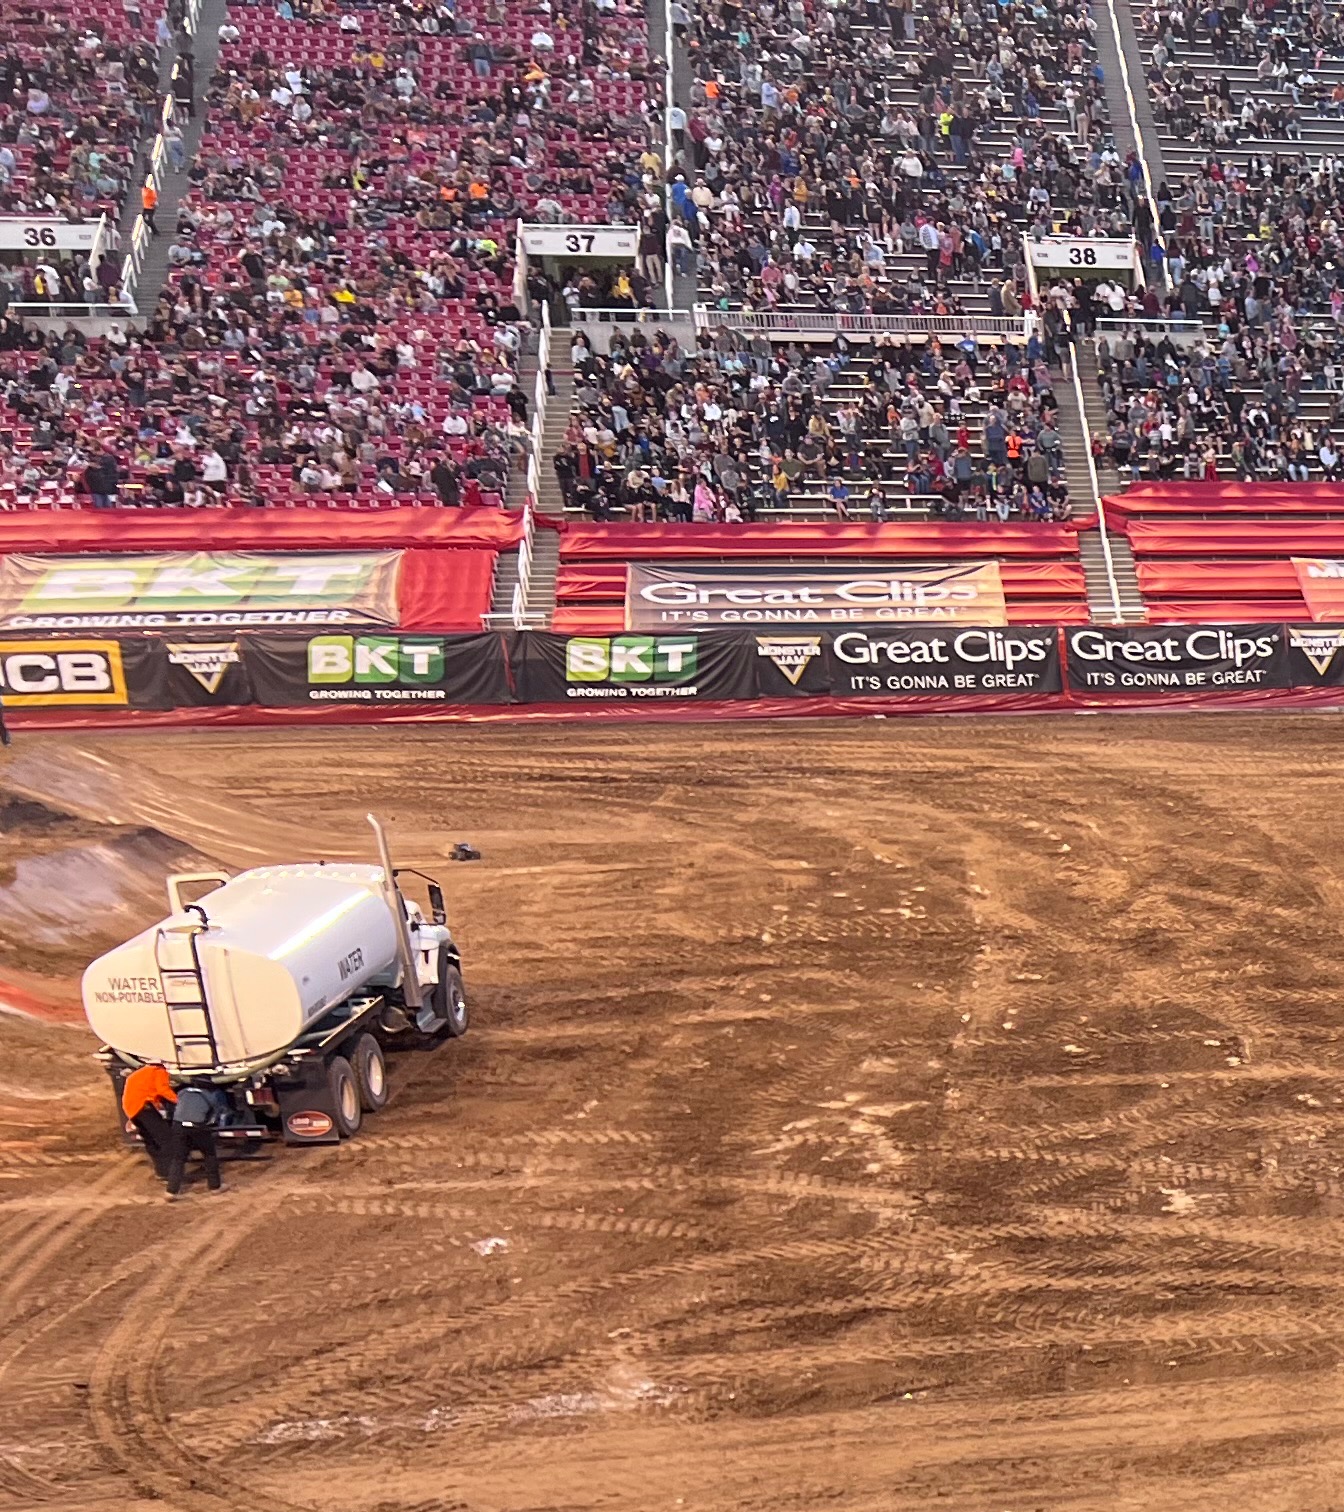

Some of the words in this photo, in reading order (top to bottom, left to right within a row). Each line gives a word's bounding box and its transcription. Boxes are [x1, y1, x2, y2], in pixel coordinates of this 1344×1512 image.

[24, 227, 57, 247] 36
[565, 234, 596, 253] 37
[1069, 247, 1097, 266] 38
[33, 564, 363, 600] BKT
[640, 581, 825, 605] Great
[835, 580, 978, 607] Clips
[9, 612, 167, 628] GROWING
[176, 609, 351, 626] TOGETHER
[661, 610, 709, 622] IT'S
[720, 608, 819, 622] GONNA
[830, 608, 864, 620] BE
[875, 606, 958, 619] GREAT
[569, 641, 694, 673] BKT
[833, 632, 950, 665] Great
[954, 631, 1045, 670] Clips
[1071, 631, 1181, 662] Great
[1185, 630, 1274, 667] Clips
[310, 644, 442, 677] BKT
[0, 653, 111, 693] CB
[851, 674, 881, 690] IT'S
[885, 674, 950, 690] GONNA
[953, 674, 978, 688] BE
[981, 673, 1037, 688] GREAT
[1086, 672, 1116, 687] IT'S
[1121, 671, 1181, 687] GONNA
[1185, 672, 1206, 686] BE
[1211, 670, 1265, 685] GREAT
[309, 690, 372, 700] GROWING
[375, 689, 446, 699] TOGETHER
[566, 686, 627, 697] GROWING
[630, 685, 698, 697] TOGETHER
[338, 947, 364, 981] WATER
[108, 977, 158, 991] WATER
[95, 991, 166, 1004] NON-POTABLE
